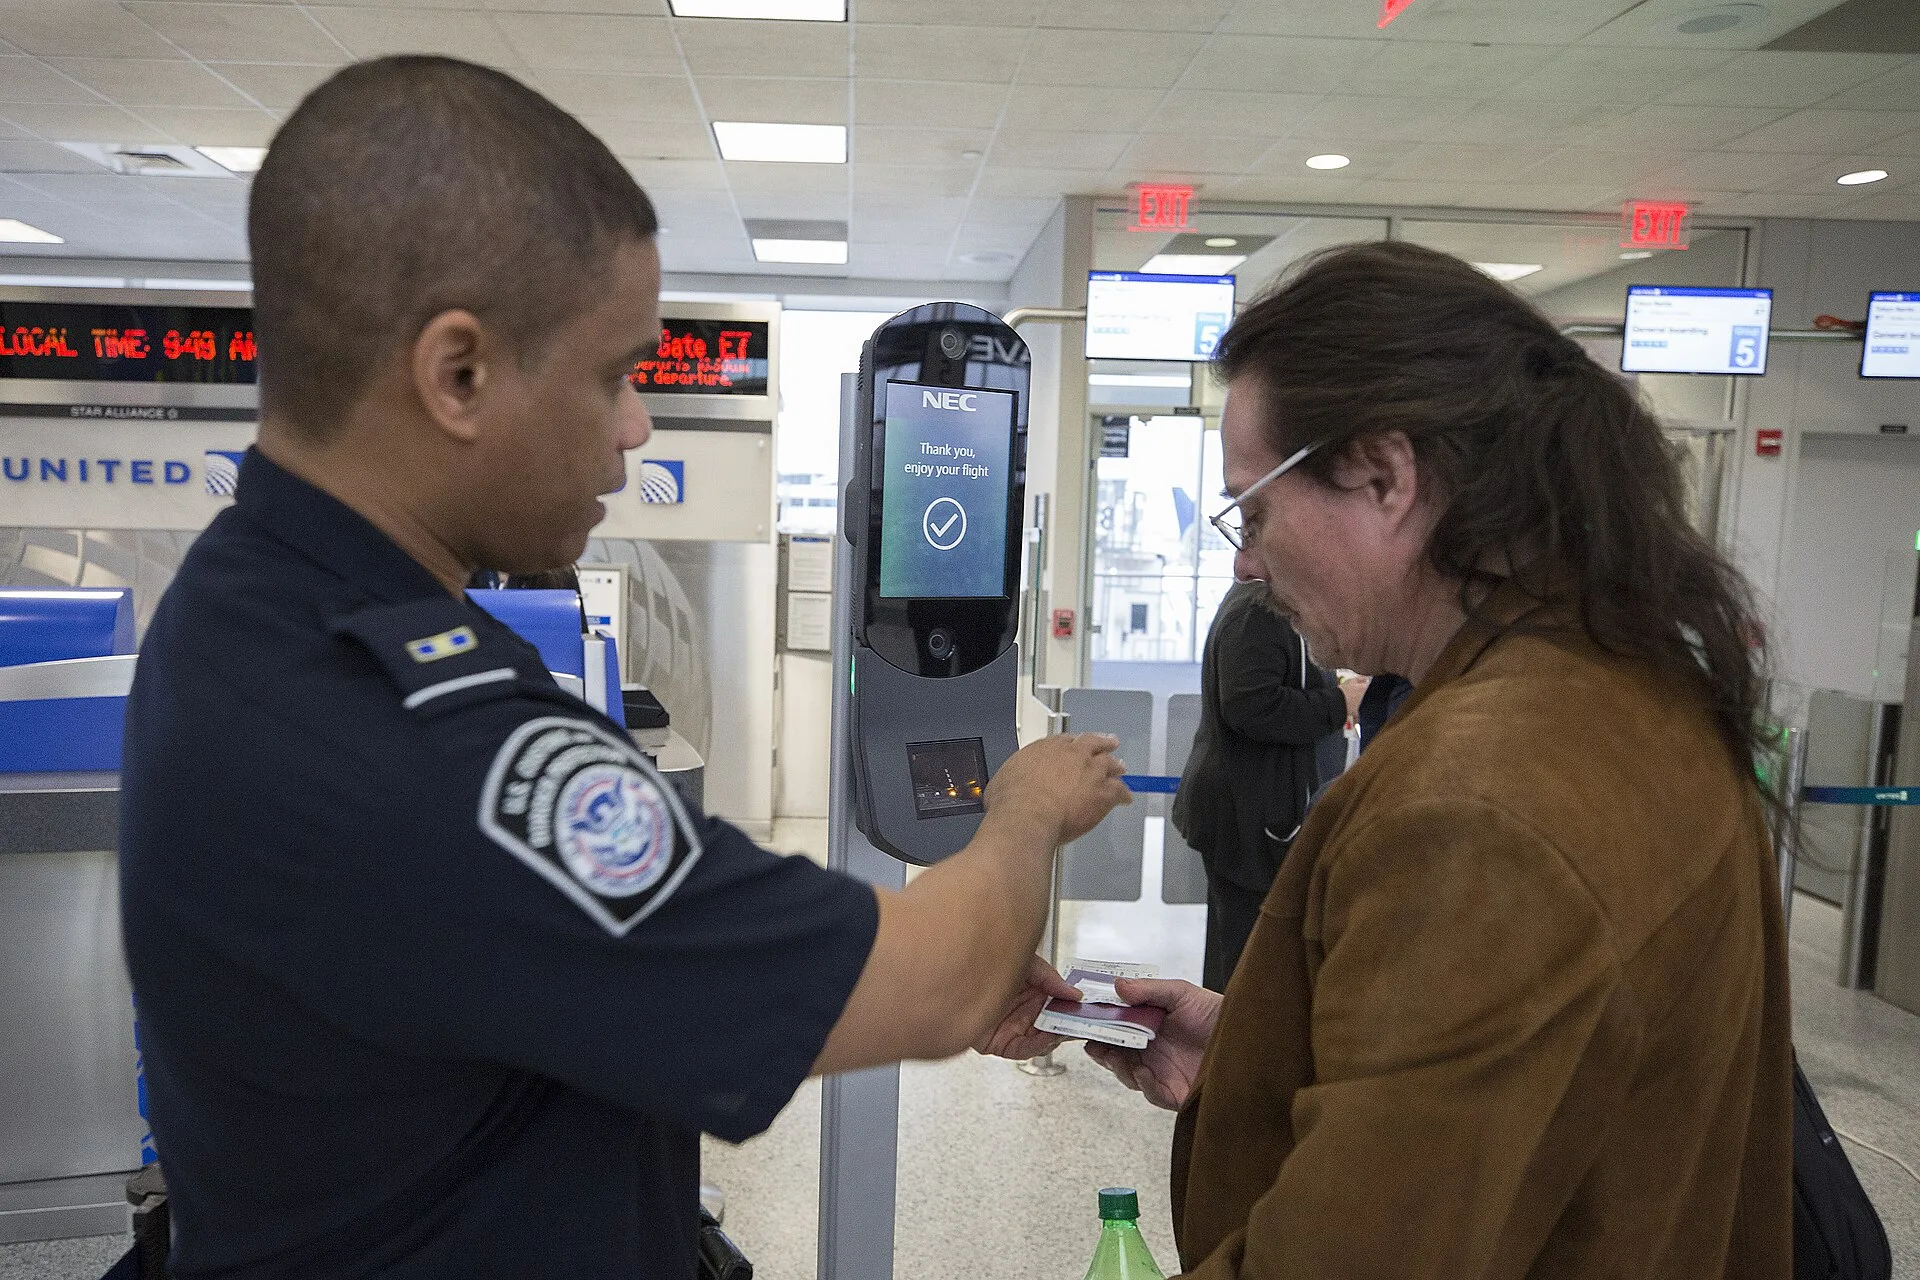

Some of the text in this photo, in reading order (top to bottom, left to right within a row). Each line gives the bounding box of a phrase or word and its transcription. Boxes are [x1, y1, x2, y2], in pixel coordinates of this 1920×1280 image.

[1139, 188, 1193, 226] EXIT
[1631, 204, 1688, 244] EXIT
[0, 326, 78, 357] LOCAL
[656, 328, 752, 360] Gate E7
[1200, 324, 1219, 353] 5
[1734, 338, 1756, 367] 5
[922, 390, 977, 412] NEC
[920, 442, 976, 460] Thank you,
[3, 457, 192, 485] UNITED
[904, 463, 989, 479] enjoy your flight
